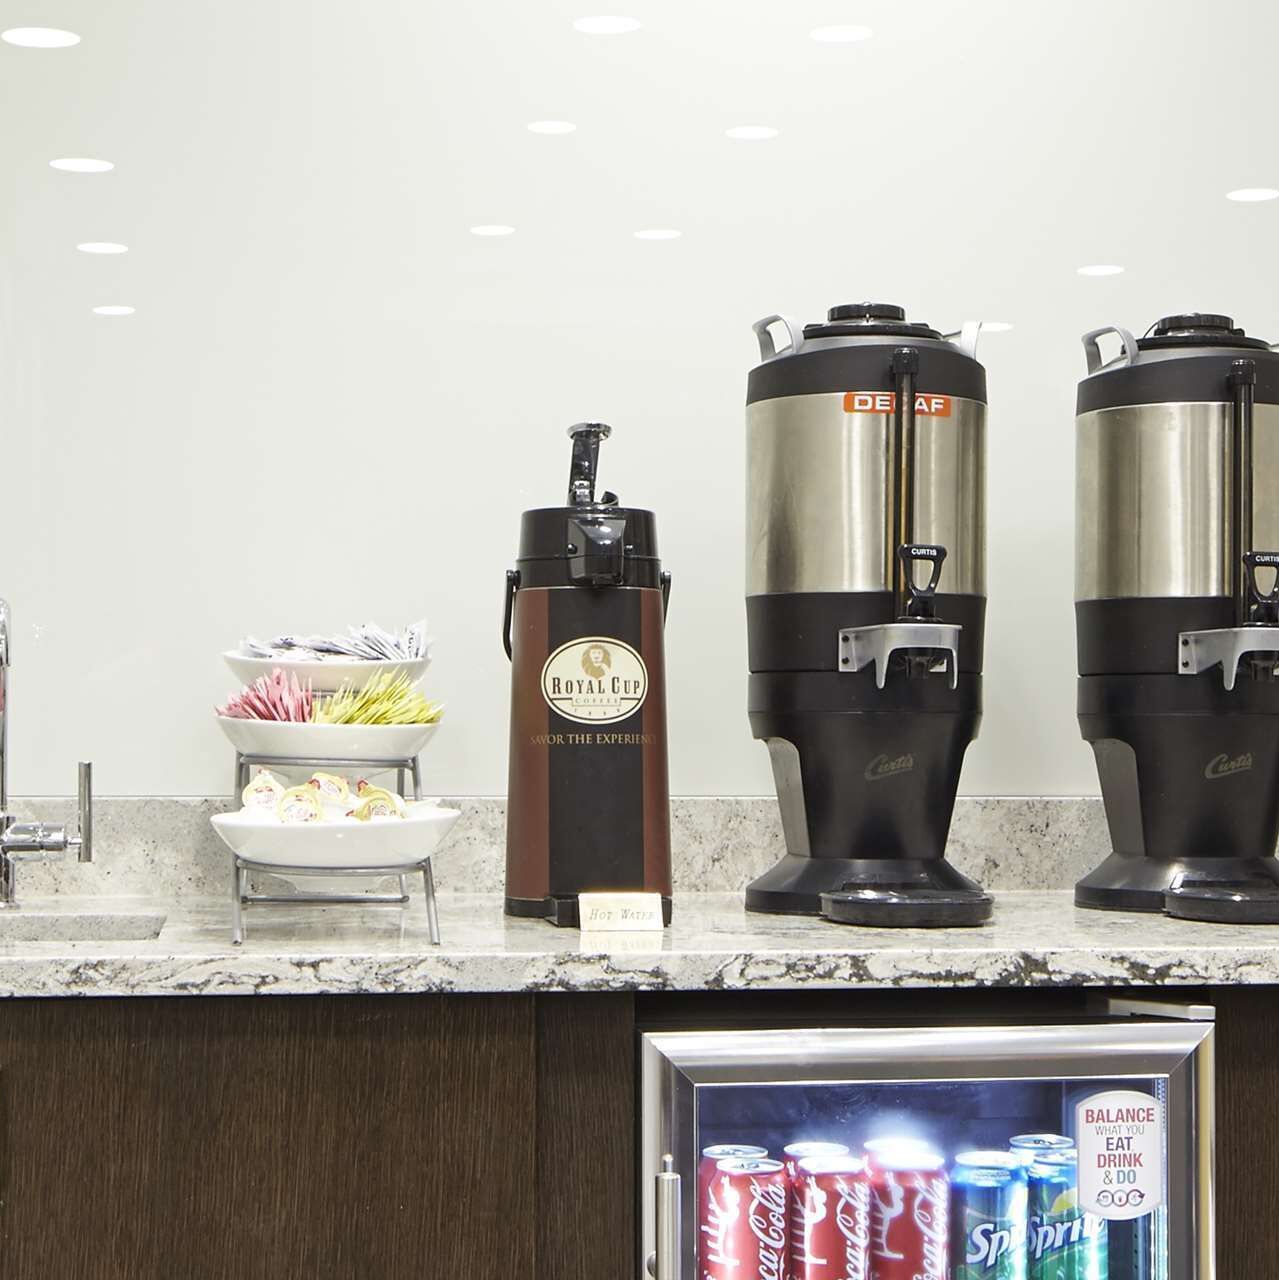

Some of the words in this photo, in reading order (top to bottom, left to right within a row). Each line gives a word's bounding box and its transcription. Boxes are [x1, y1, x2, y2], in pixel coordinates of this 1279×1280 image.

[853, 395, 945, 413] DEAF
[911, 547, 937, 556] CURTIS
[552, 677, 605, 694] ROYAL
[611, 676, 640, 694] CUP
[567, 734, 592, 744] THE
[1085, 1108, 1155, 1123] BALANCE
[1095, 1124, 1122, 1135] WHAT
[1126, 1124, 1145, 1135] YOU
[1106, 1136, 1133, 1151] EAT
[1097, 1152, 1144, 1168] DRINK
[1103, 1170, 1113, 1185] &
[1117, 1169, 1137, 1184] DO
